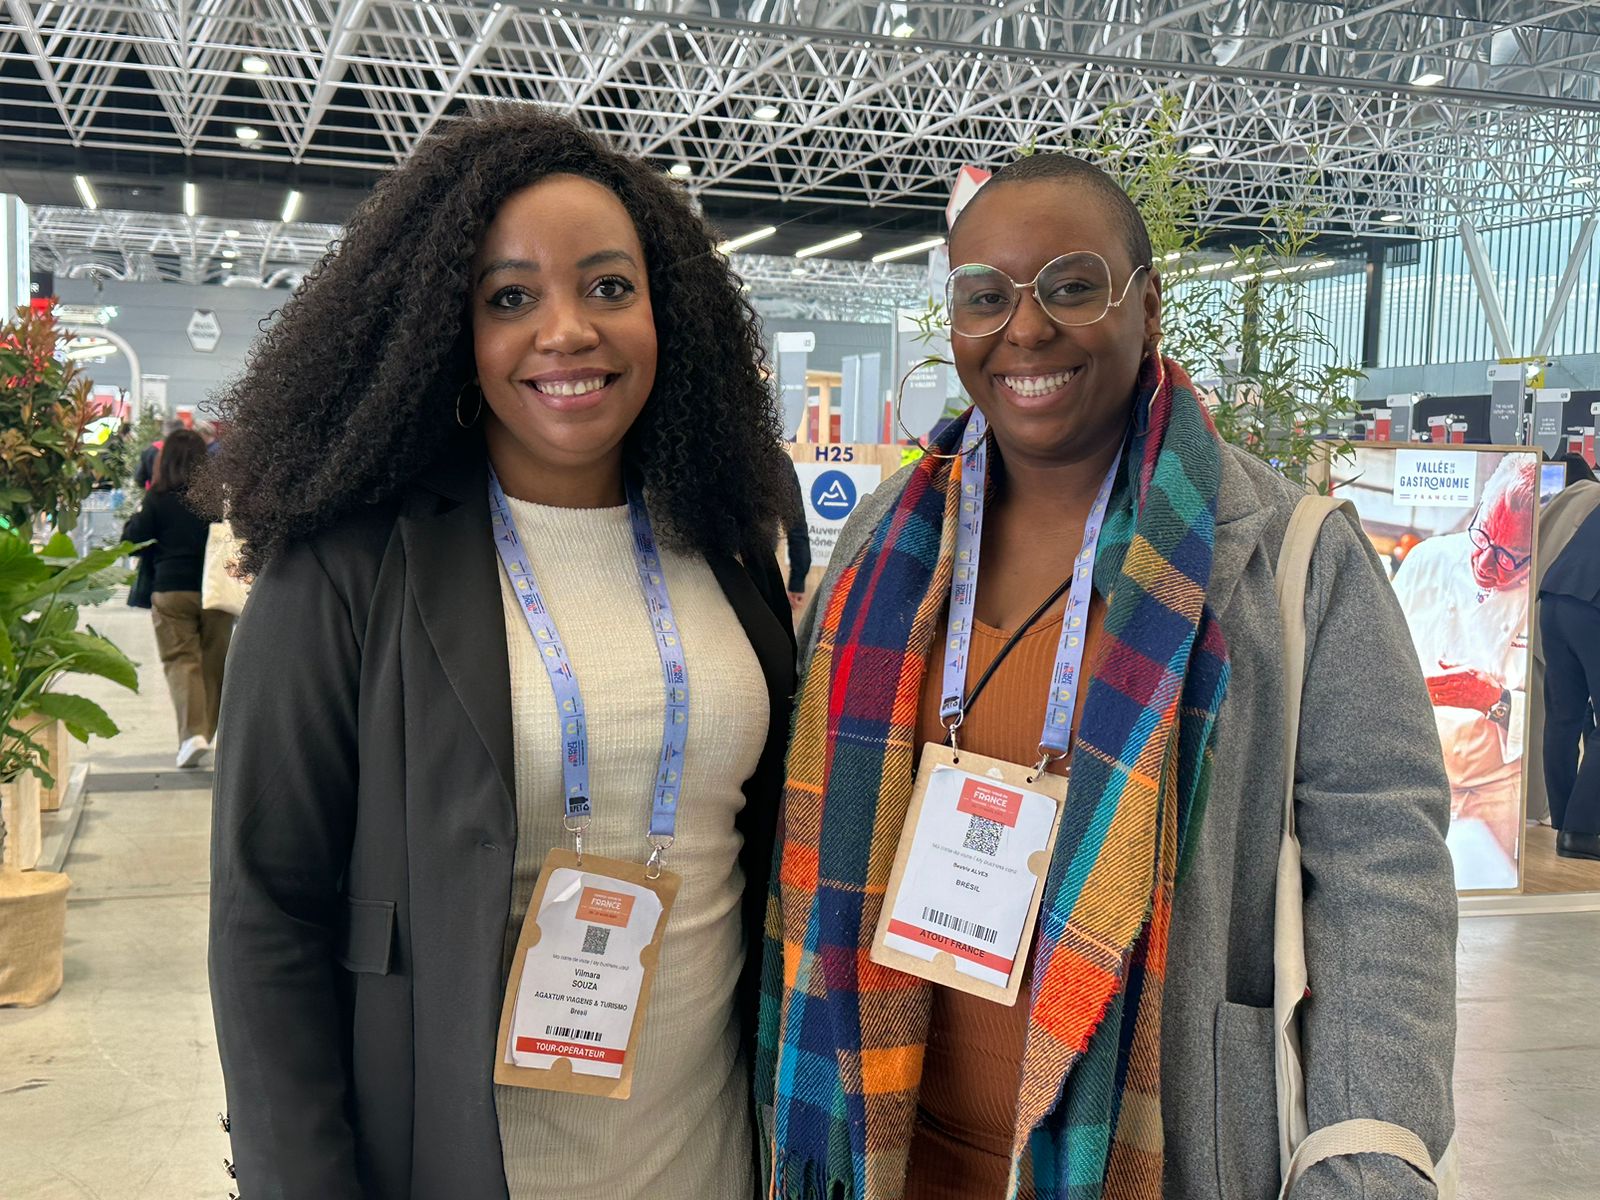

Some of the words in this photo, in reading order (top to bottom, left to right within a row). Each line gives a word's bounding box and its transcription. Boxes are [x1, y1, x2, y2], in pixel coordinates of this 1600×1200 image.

[816, 446, 854, 462] H25
[1416, 460, 1449, 474] VALLÉE
[1400, 476, 1470, 490] GASTRONOMIE
[808, 525, 842, 535] Auver
[974, 790, 1008, 808] FRANCE
[590, 897, 622, 910] FRANCE
[920, 929, 950, 944] ATOUT
[950, 939, 985, 958] FRANCE
[574, 968, 600, 980] Vilmara
[572, 980, 598, 991] SOUZA
[534, 991, 565, 1002] AGAXTUR
[566, 996, 593, 1006] VIAGENS
[600, 1000, 628, 1012] TURISMO
